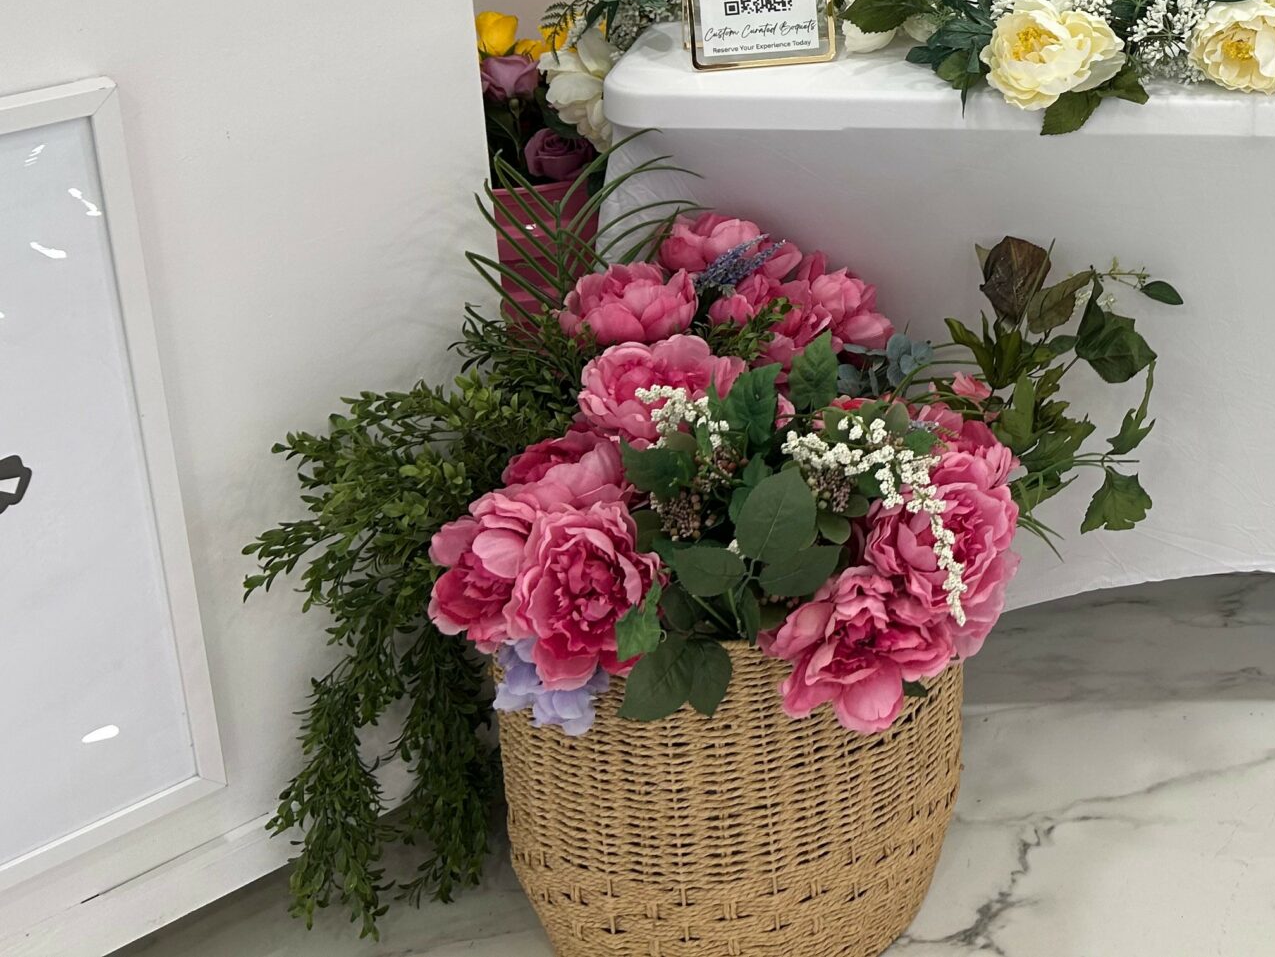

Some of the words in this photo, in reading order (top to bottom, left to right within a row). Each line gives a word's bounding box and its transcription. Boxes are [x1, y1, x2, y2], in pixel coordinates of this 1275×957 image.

[704, 26, 739, 42] Custom
[741, 22, 778, 39] Curated
[712, 46, 739, 54] Reserve
[740, 44, 754, 52] Your
[755, 42, 791, 50] Experience
[792, 39, 811, 47] Today
